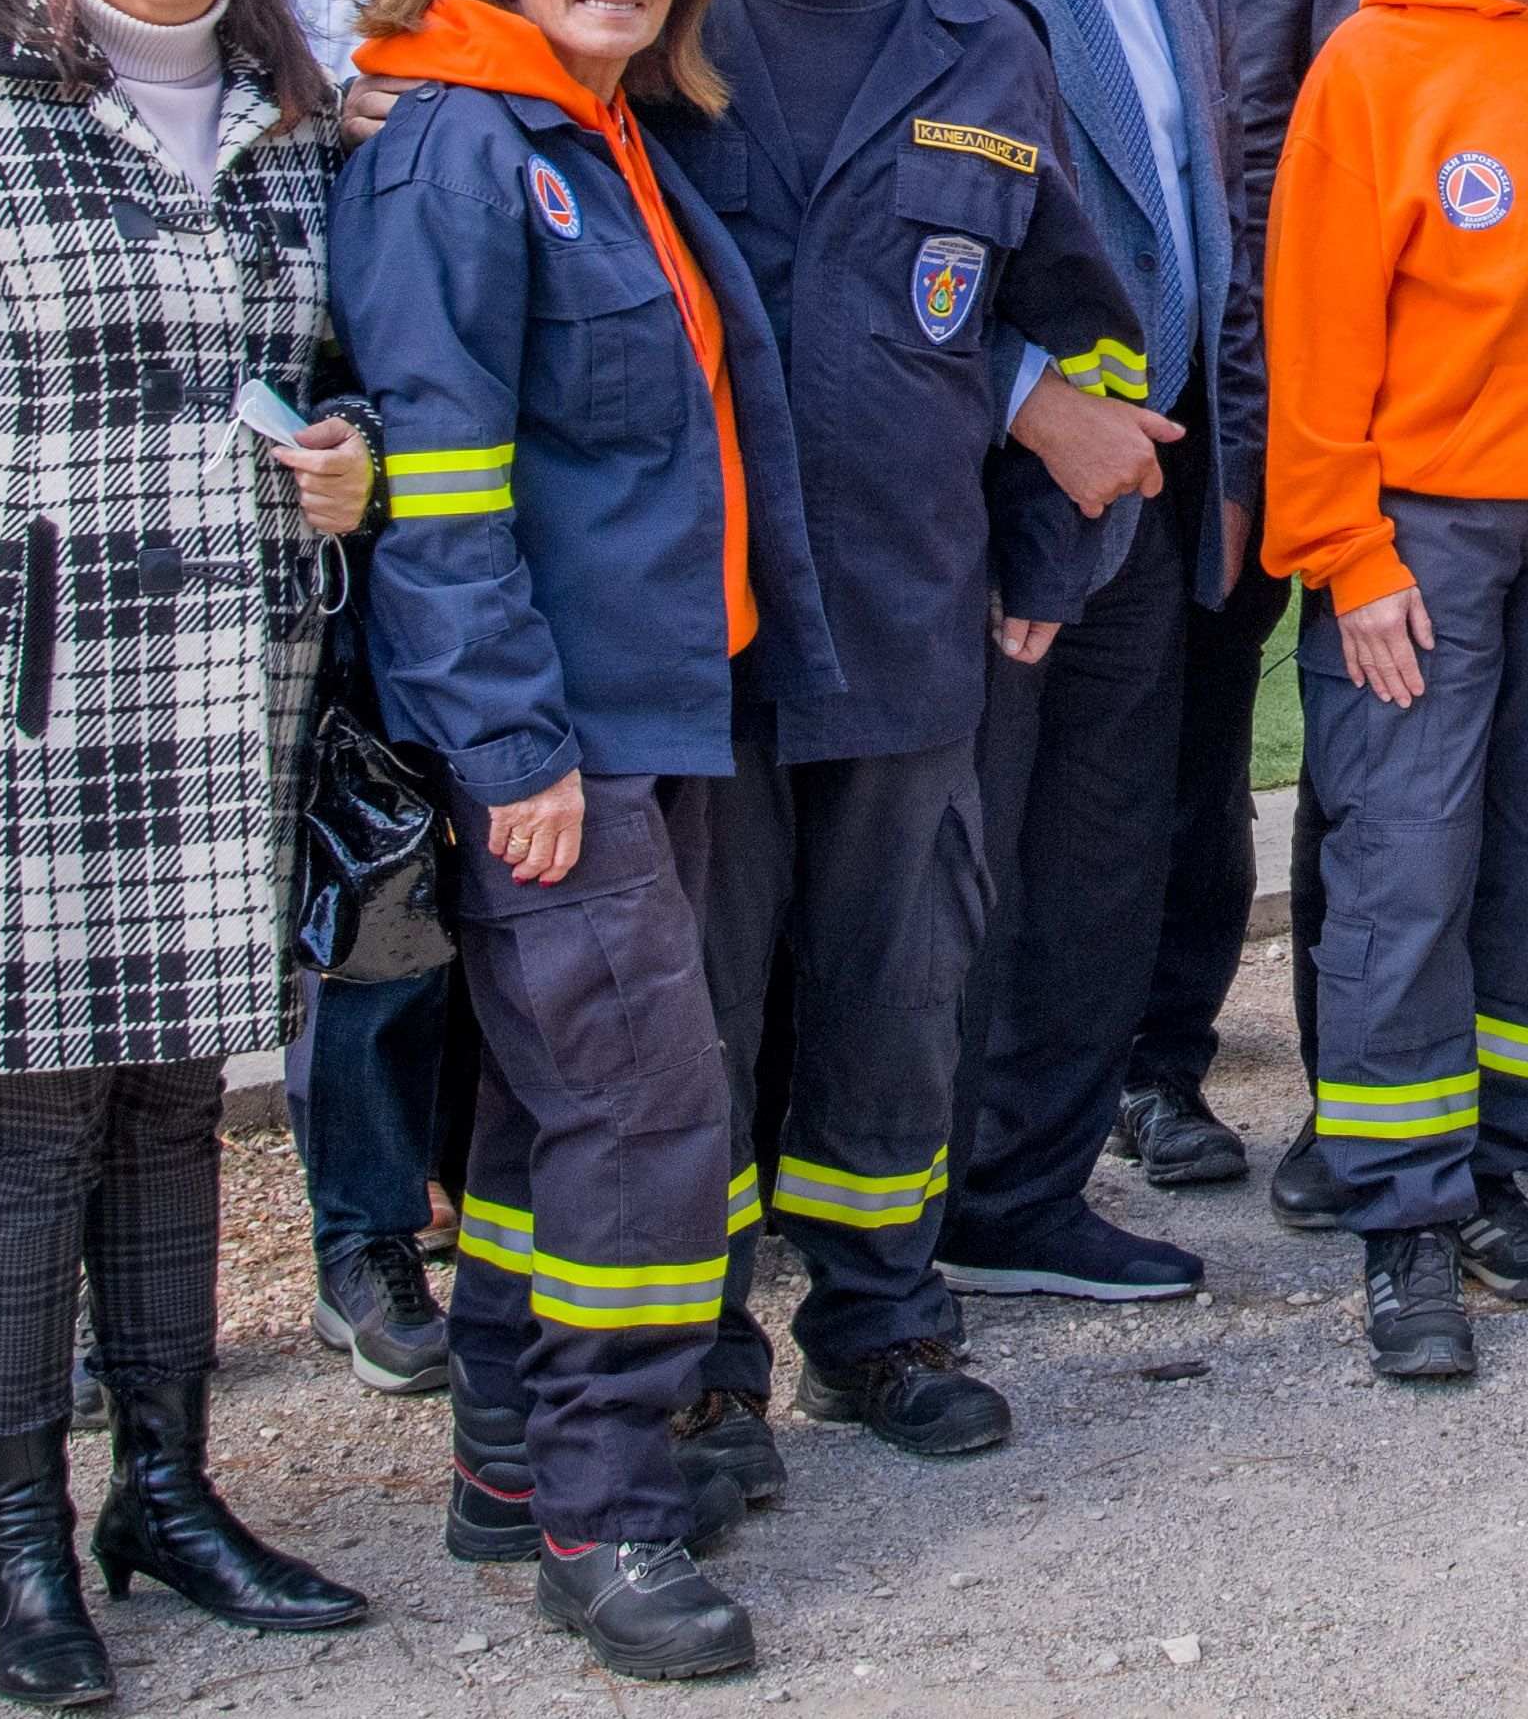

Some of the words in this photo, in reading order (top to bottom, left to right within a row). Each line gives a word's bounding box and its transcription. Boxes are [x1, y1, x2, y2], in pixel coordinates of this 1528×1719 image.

[920, 125, 1013, 160] ΚΑΝΕΛΛΙΔΗΣ
[1438, 157, 1460, 209] ΠΟΛΙΤΙΚΗ
[1462, 153, 1511, 194] ΠΡΟΣΤΑΣΙΑ
